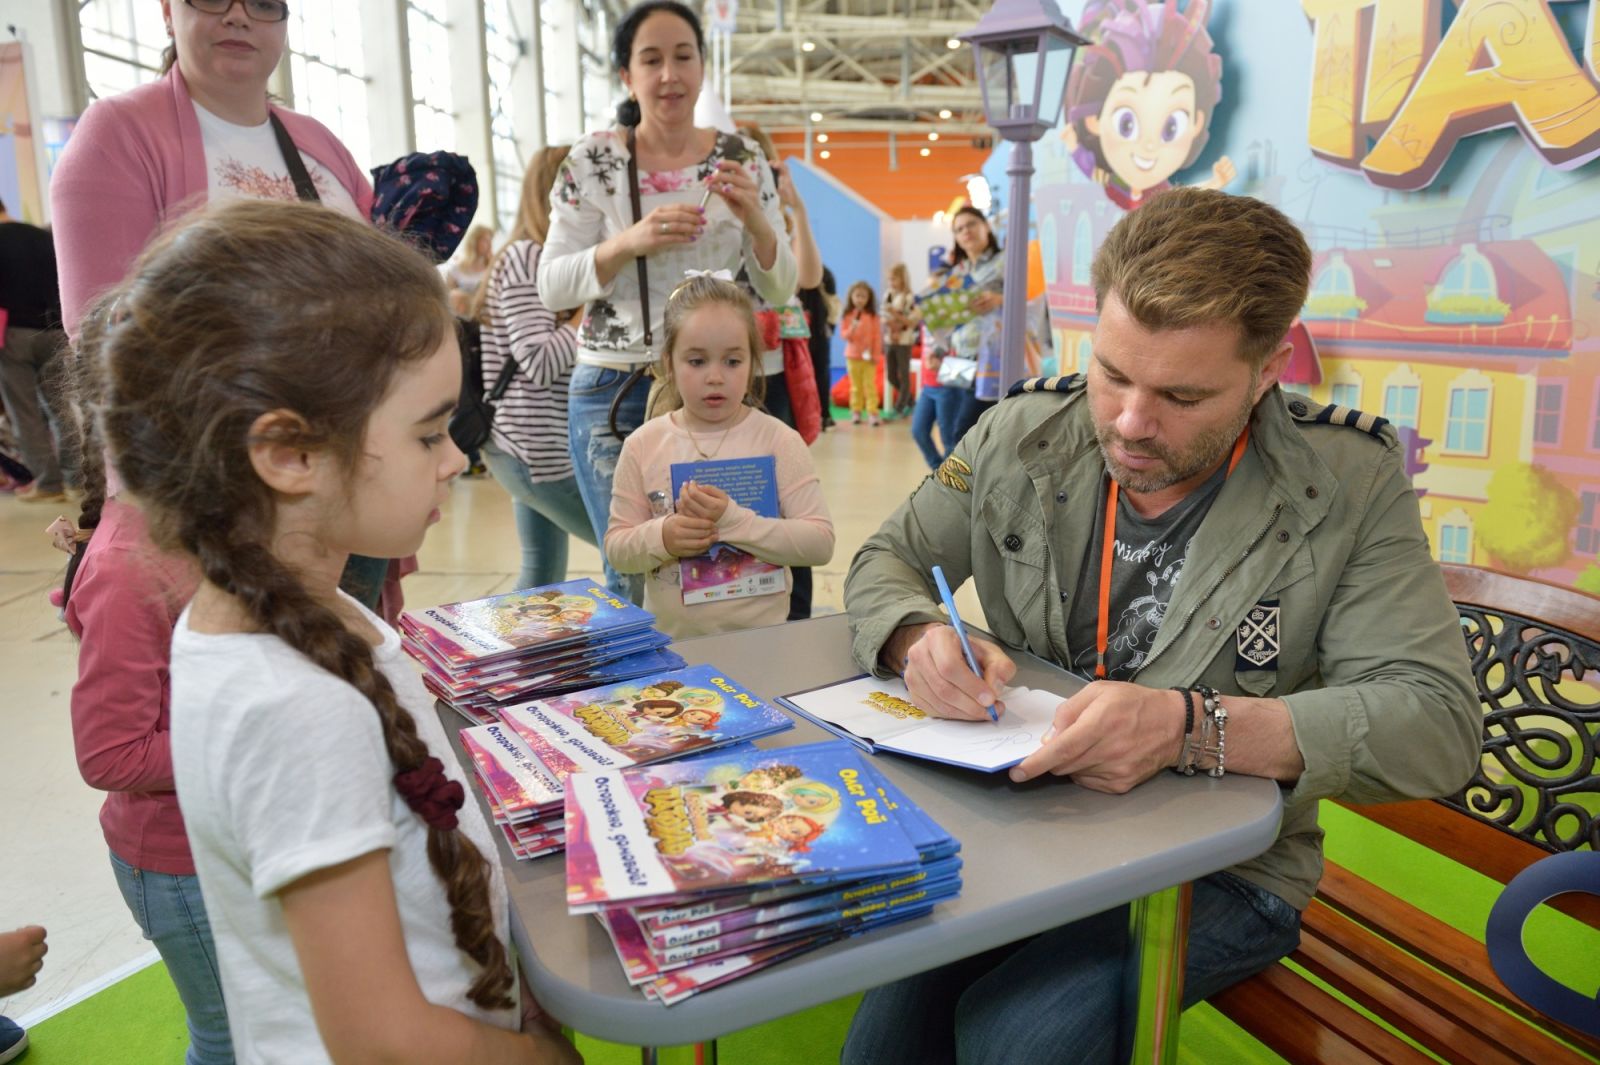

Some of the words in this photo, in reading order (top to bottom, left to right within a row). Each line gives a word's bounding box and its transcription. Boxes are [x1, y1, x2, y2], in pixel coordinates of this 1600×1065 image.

[710, 677, 737, 693] Олег
[733, 693, 760, 709] Рой
[526, 706, 570, 738] Осторожно,
[563, 738, 614, 766] домовой!
[595, 776, 623, 832] Осторожно,
[839, 768, 866, 797] Олег
[856, 798, 888, 824] Рой
[607, 834, 648, 887] домовой!
